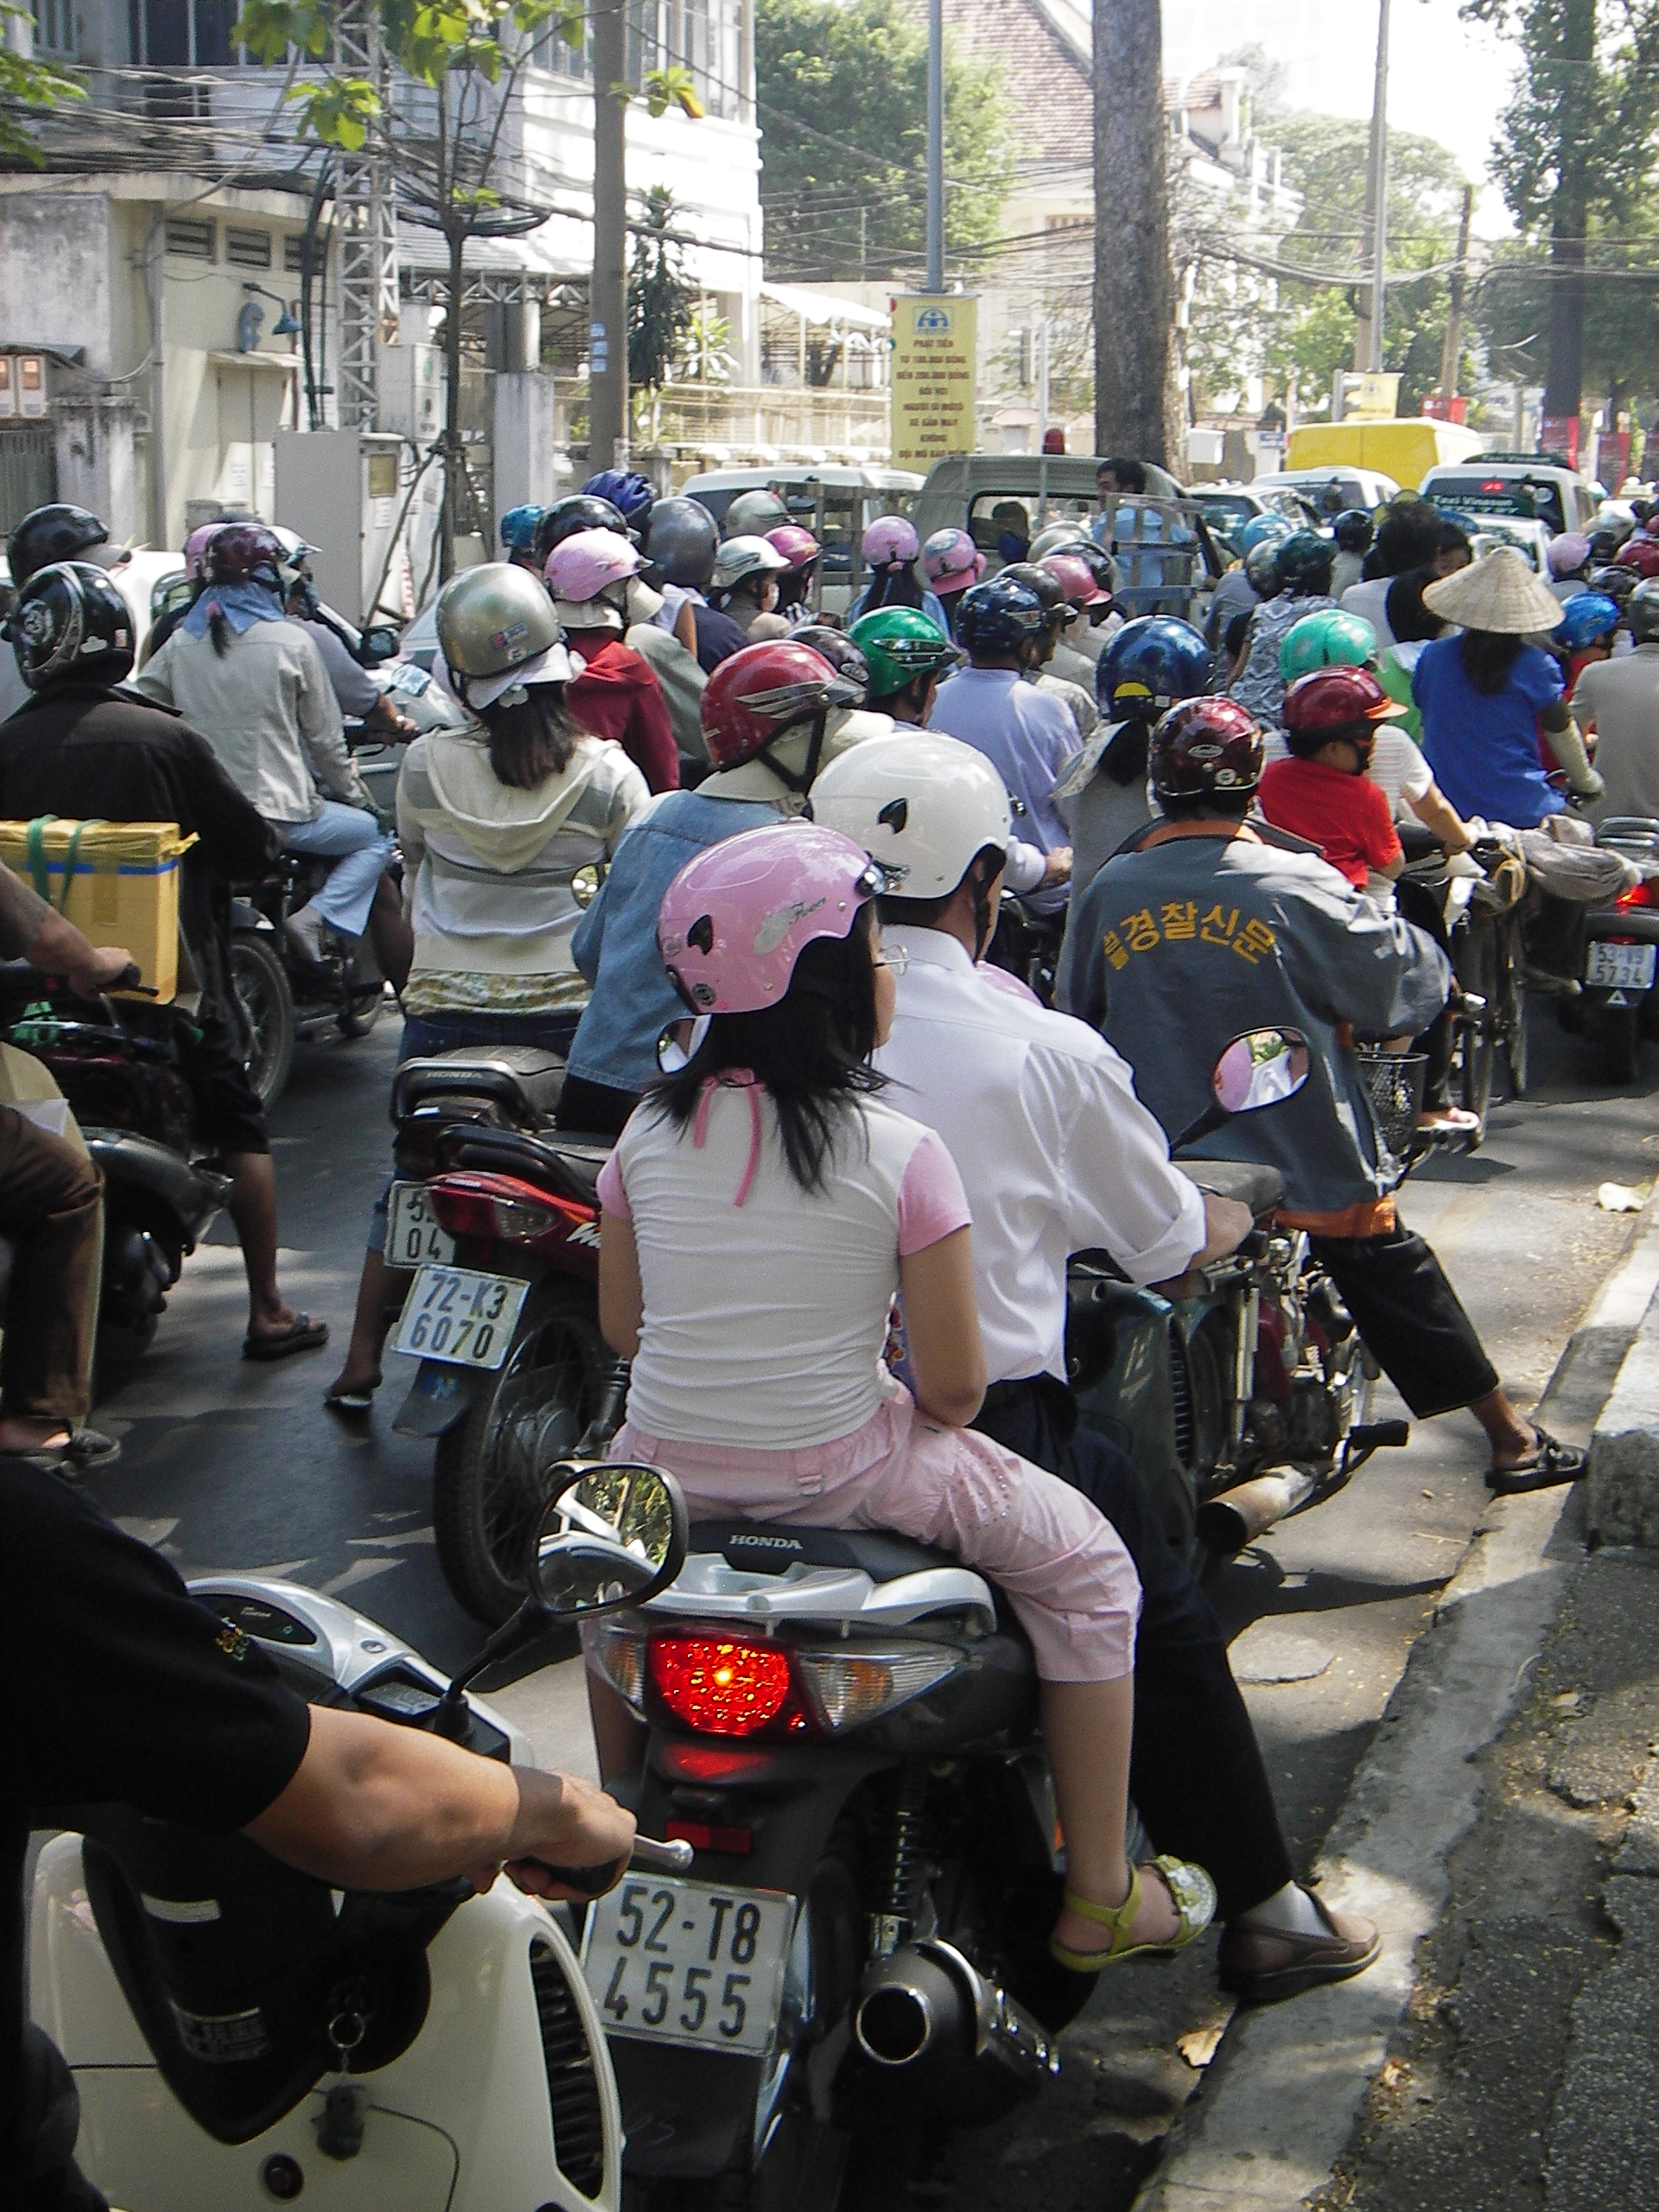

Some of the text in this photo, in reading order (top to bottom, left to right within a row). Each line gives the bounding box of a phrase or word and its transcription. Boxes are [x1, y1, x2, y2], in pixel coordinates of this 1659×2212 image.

[423, 1273, 509, 1320] 72-K3
[410, 1313, 494, 1360] 6070
[729, 1534, 804, 1550] HONDA
[616, 1883, 760, 1964] 52-T8
[604, 1955, 751, 2037] 4555
